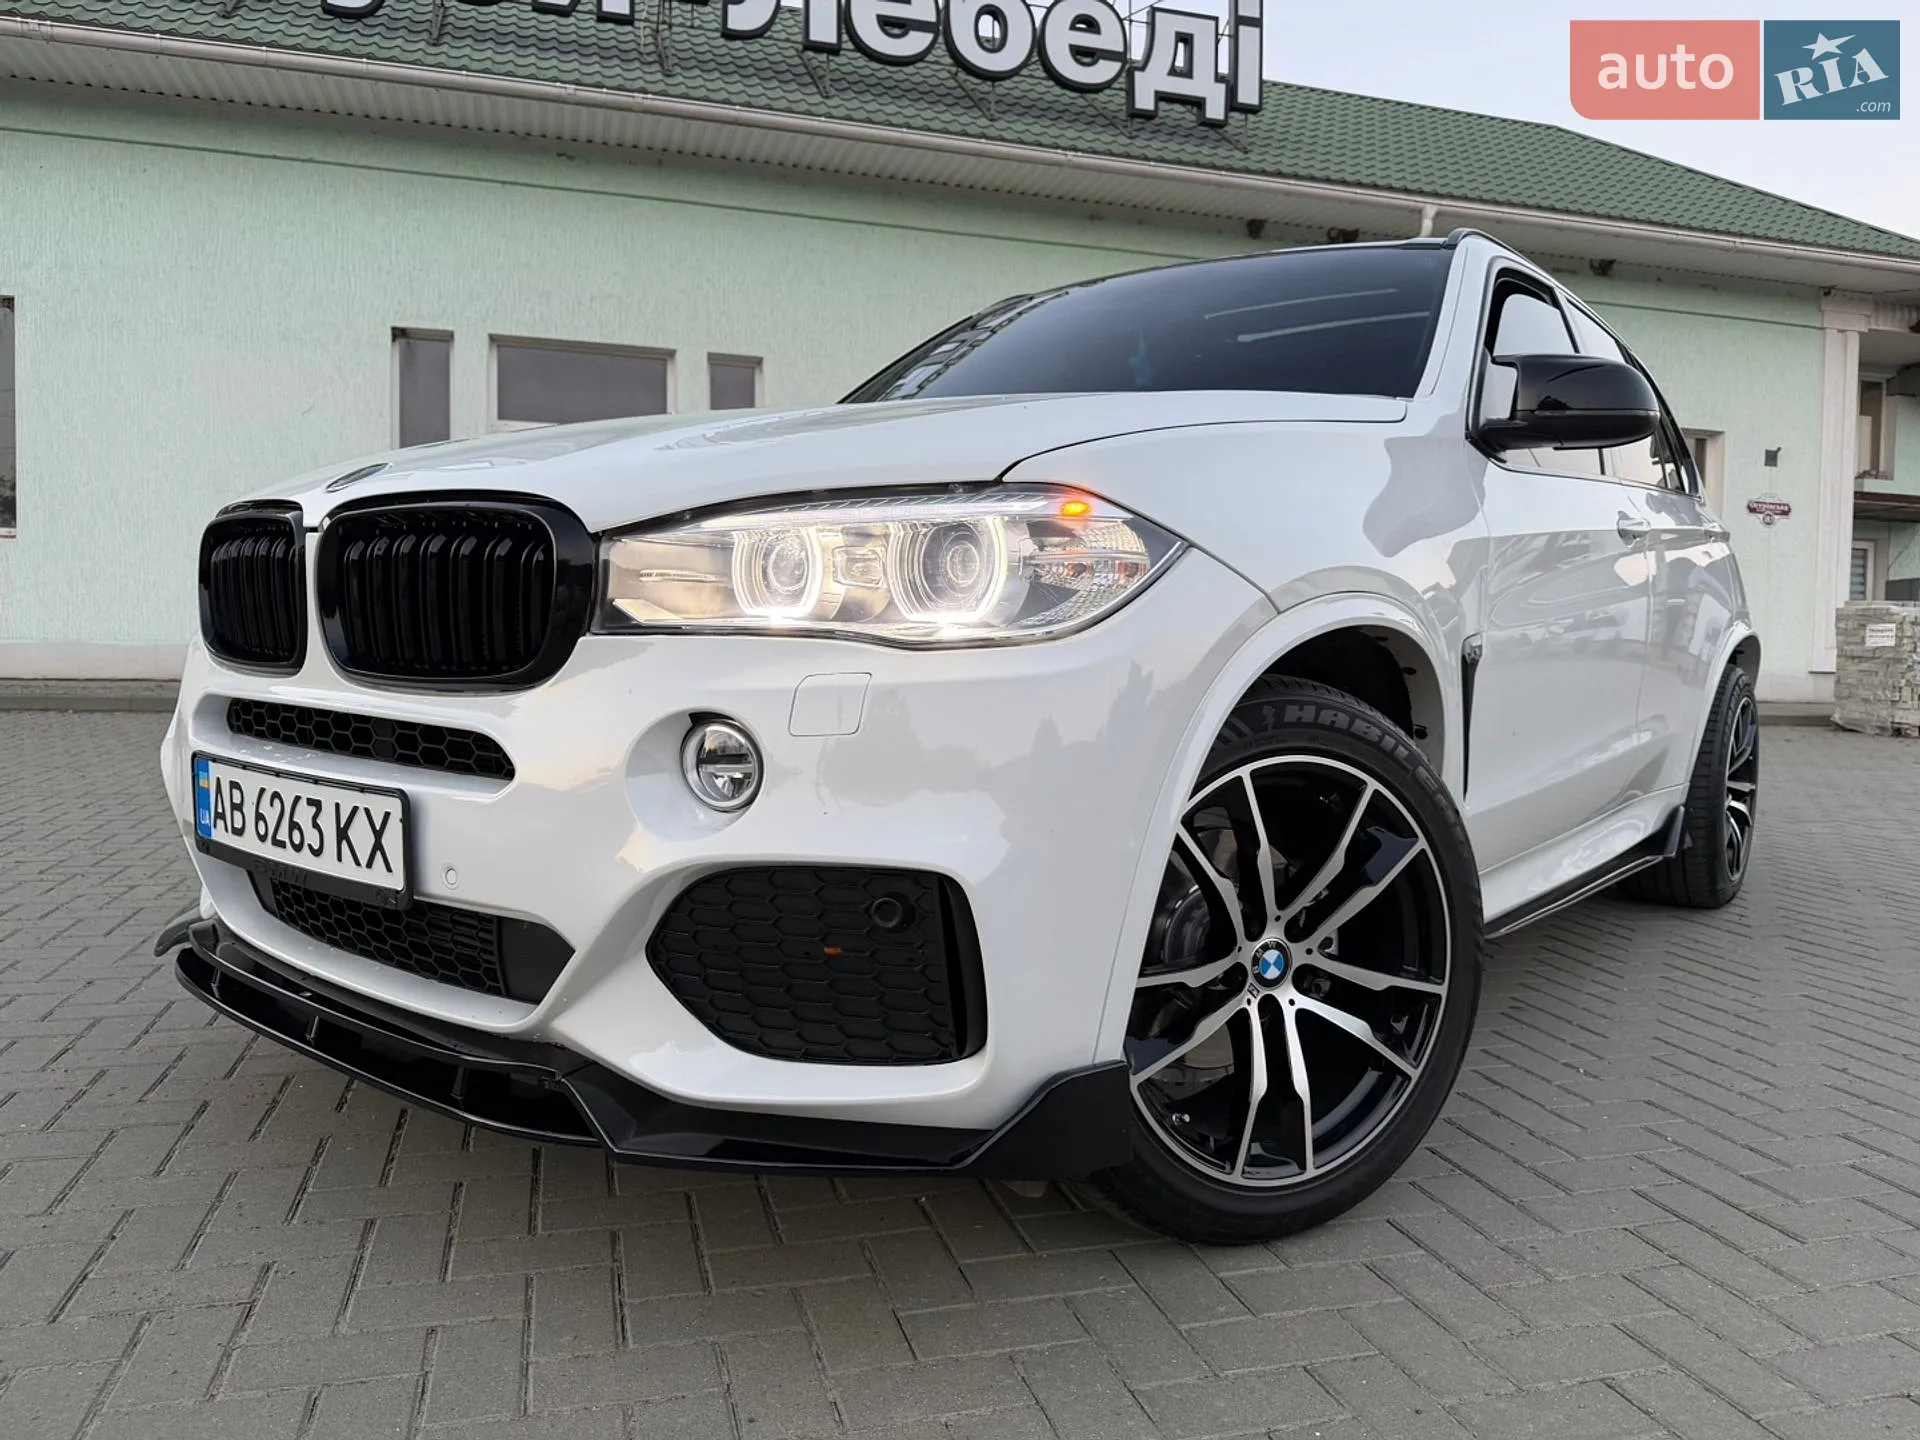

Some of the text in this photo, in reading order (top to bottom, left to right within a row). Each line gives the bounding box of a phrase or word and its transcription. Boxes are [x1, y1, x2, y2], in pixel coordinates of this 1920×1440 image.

[213, 776, 246, 837] AB
[254, 786, 324, 857] 6263
[334, 801, 394, 873] KX
